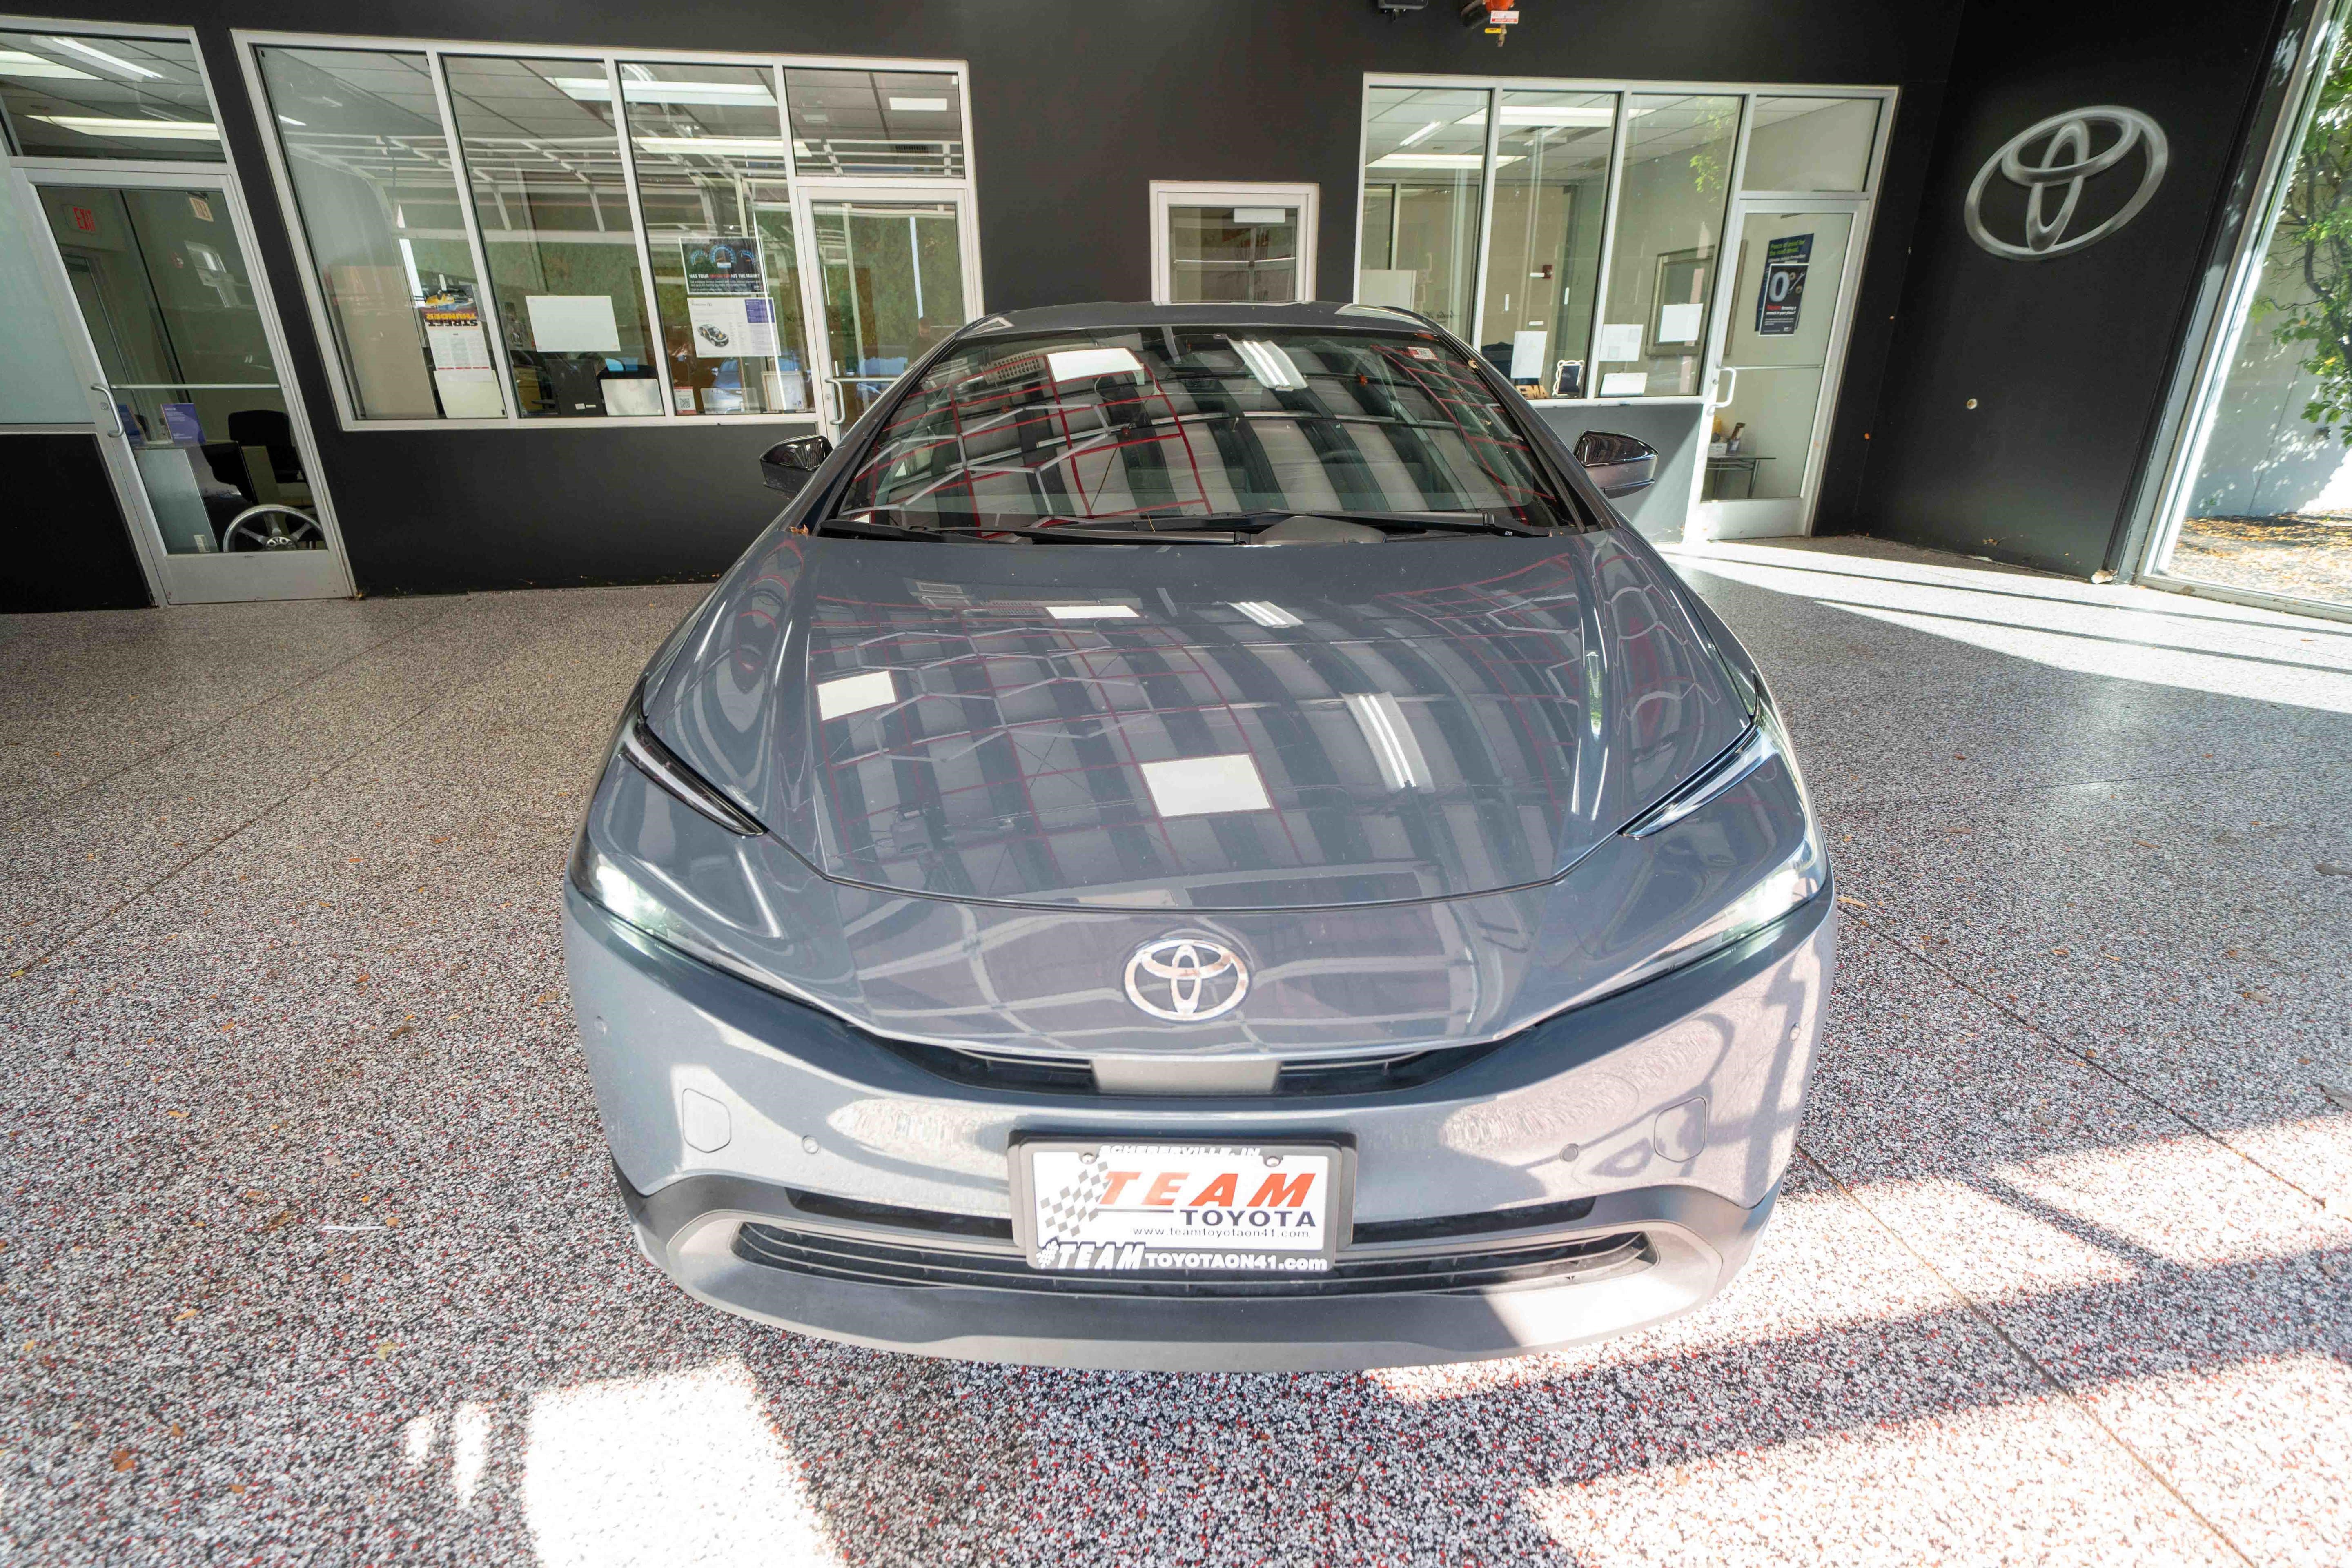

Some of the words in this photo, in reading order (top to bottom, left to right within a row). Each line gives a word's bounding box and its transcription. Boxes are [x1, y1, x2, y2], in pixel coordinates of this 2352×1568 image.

[73, 207, 95, 231] EXIT
[1099, 1171, 1316, 1207] TEAM
[1180, 1209, 1316, 1227] TOYOTA
[1133, 1227, 1309, 1238] www.teamtoyotaon41.com
[1058, 1243, 1145, 1270] TEAM
